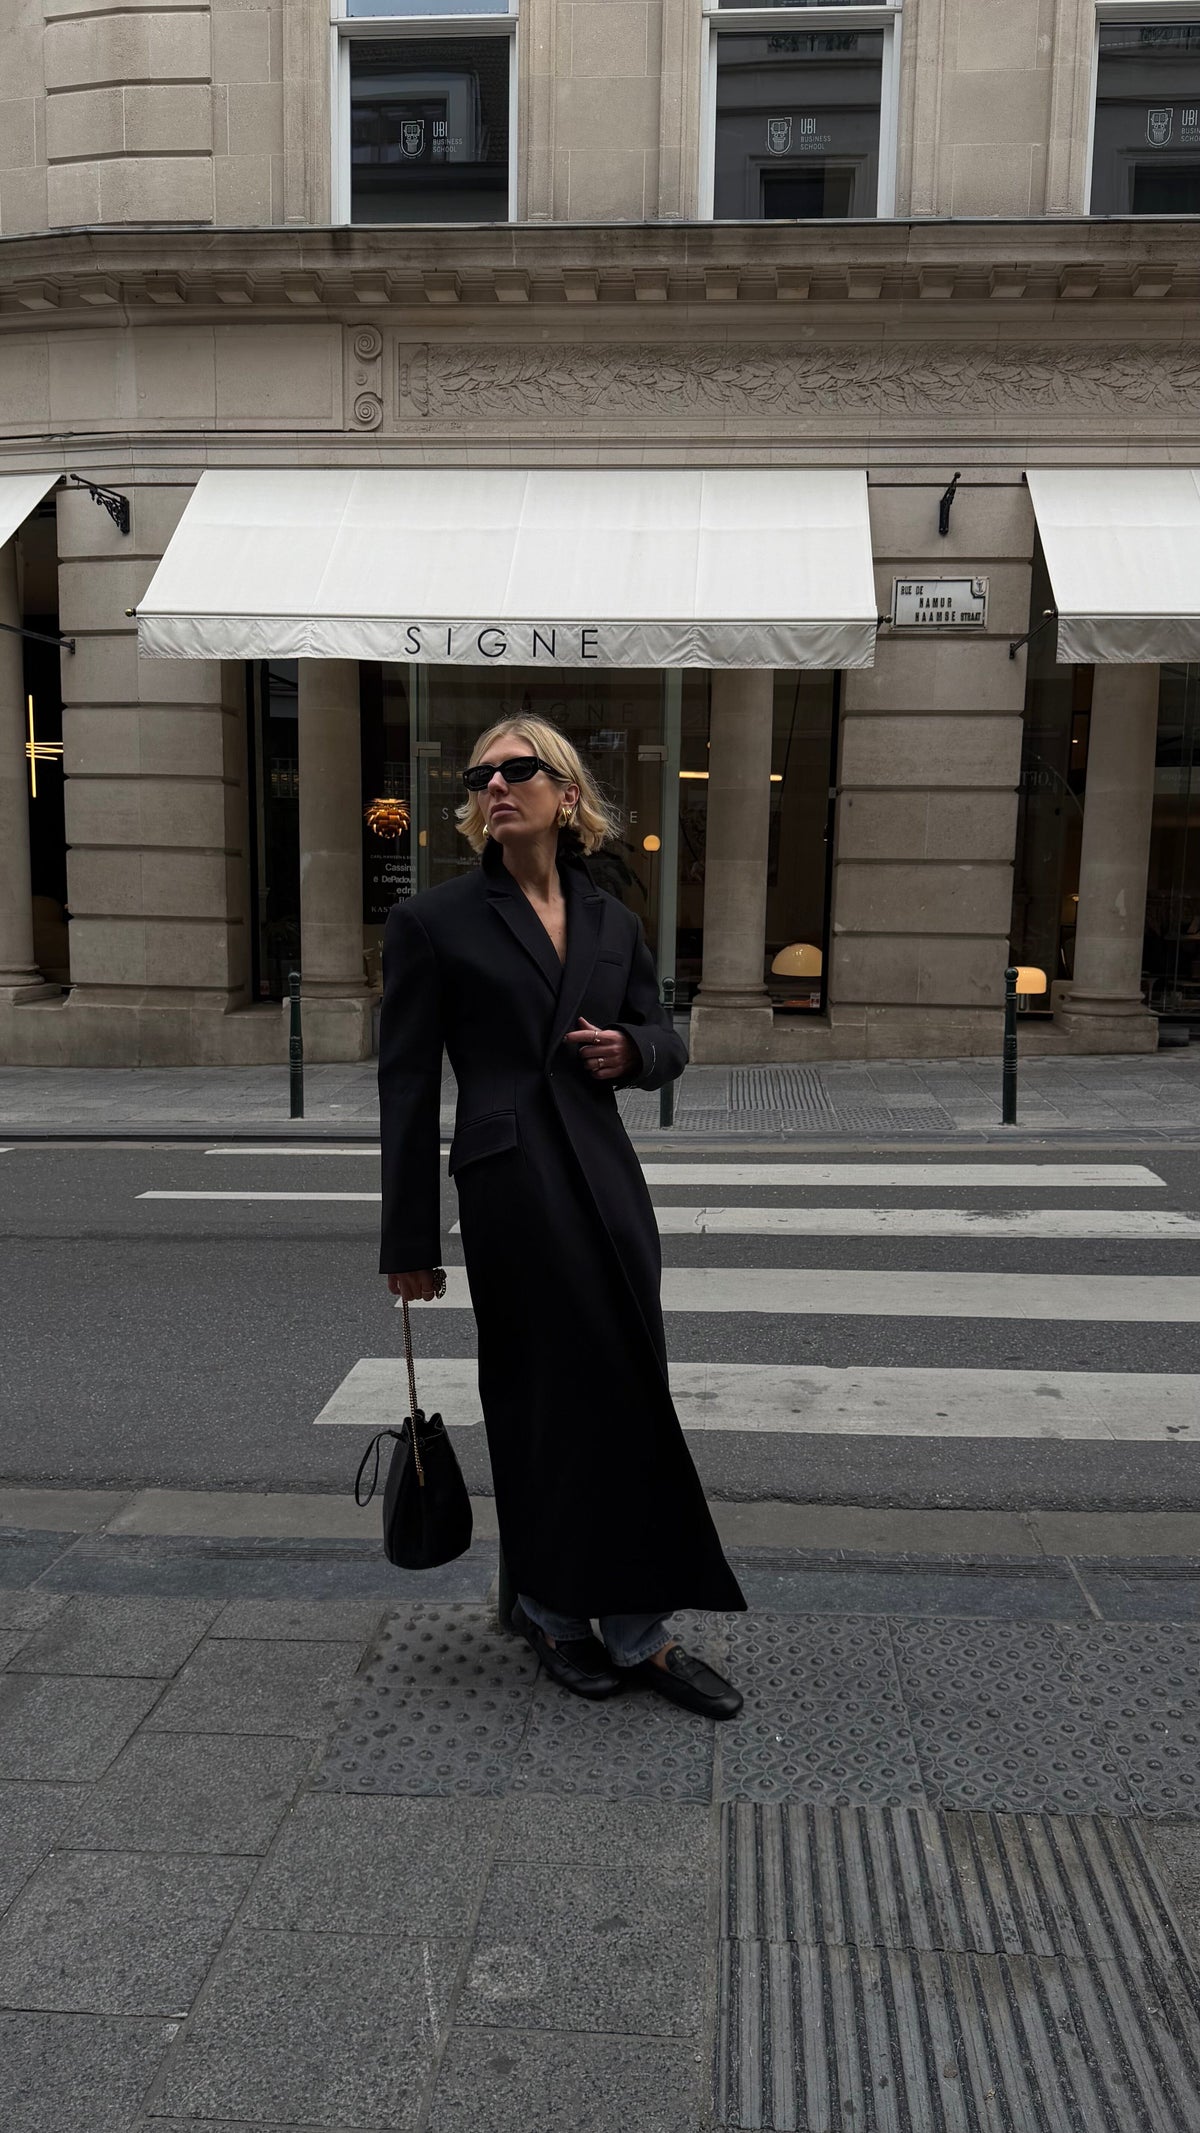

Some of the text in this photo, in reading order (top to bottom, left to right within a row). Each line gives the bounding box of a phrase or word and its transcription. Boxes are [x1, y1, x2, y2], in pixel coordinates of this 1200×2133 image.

[1182, 109, 1198, 126] UBI
[432, 121, 448, 137] UBI
[800, 118, 816, 134] UBI
[432, 137, 463, 146] BUSINESS
[800, 135, 832, 143] BUSINESS
[432, 145, 457, 153] SCHOOL
[800, 143, 825, 151] SCHOOL
[901, 586, 924, 595] RUE DE
[919, 597, 953, 608] NAMUR
[915, 611, 981, 622] NAAMSE STRAAT
[404, 626, 598, 659] SIGNE
